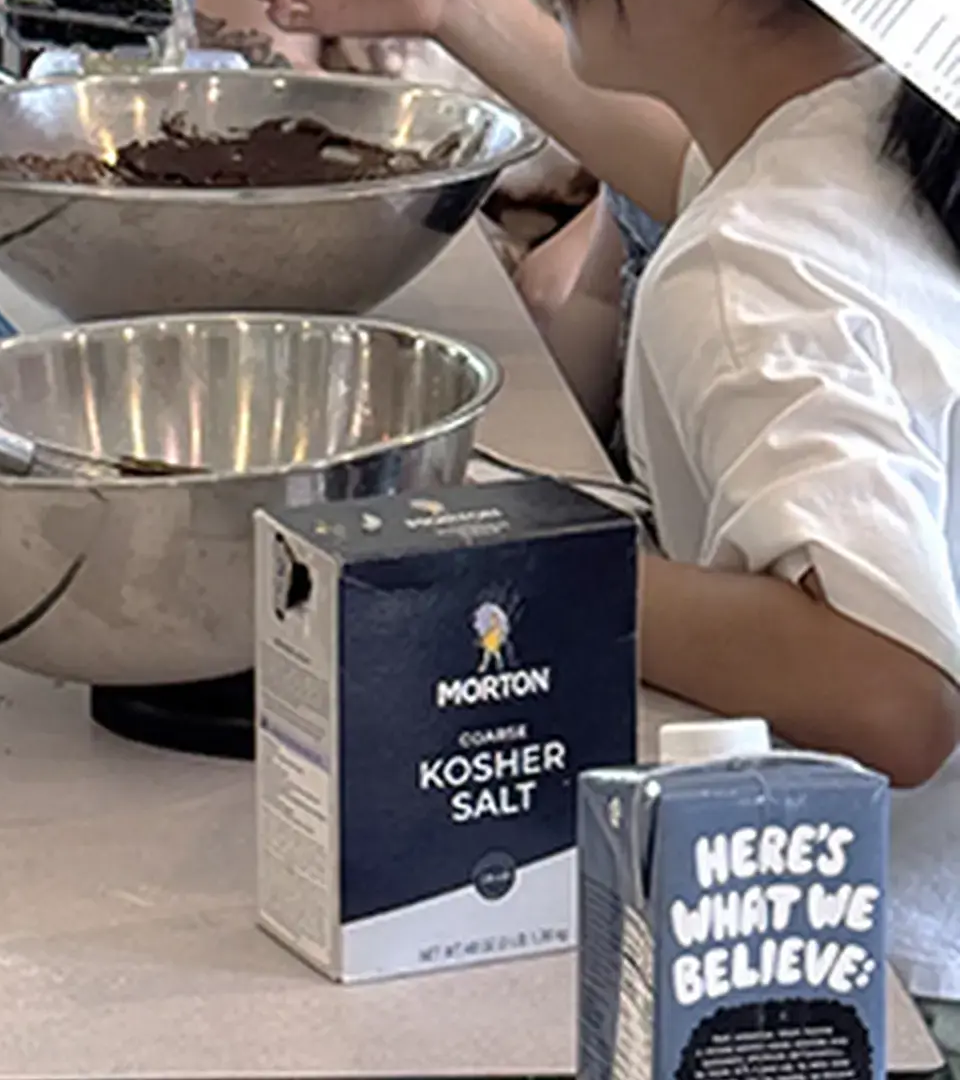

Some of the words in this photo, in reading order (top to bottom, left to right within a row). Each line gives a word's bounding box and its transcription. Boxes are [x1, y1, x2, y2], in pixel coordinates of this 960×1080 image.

[437, 667, 551, 708] MORTON
[458, 723, 527, 749] COARSE
[419, 740, 566, 790] KOSHER
[451, 780, 537, 822] SALT
[695, 822, 855, 888] HERE'S
[671, 883, 802, 947] WHAT
[807, 882, 880, 932] WE
[673, 936, 876, 1006] BELIEVE:
